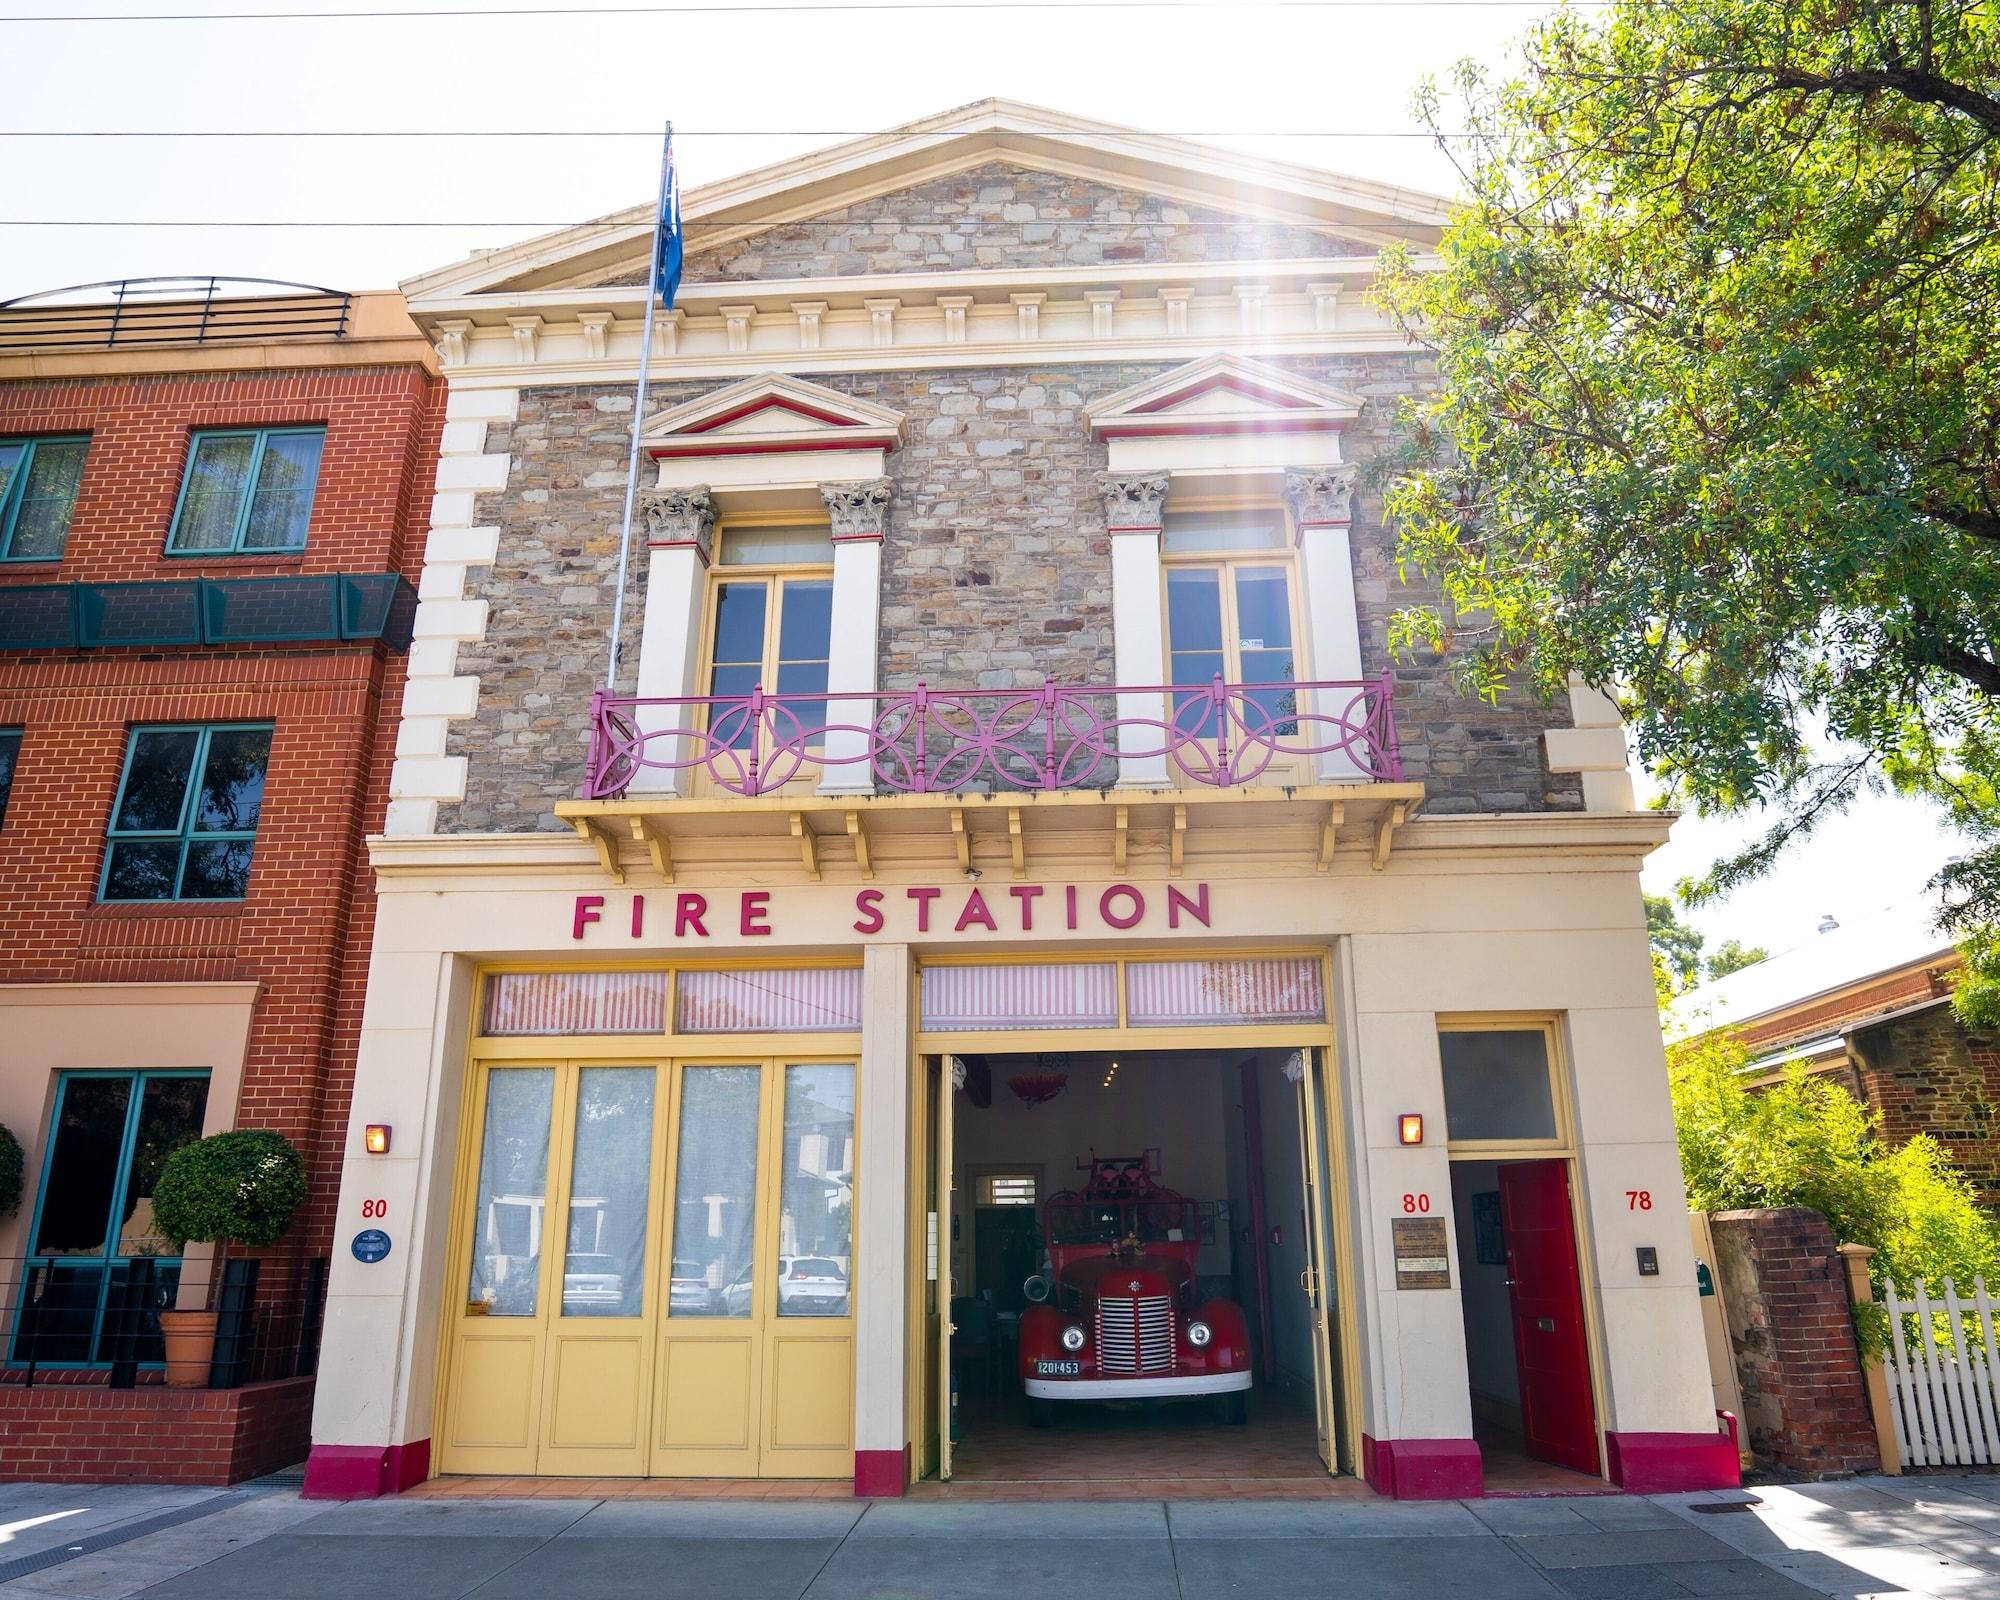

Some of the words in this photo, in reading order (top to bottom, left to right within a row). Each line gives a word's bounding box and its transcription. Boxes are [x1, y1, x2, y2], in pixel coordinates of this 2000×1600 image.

[573, 891, 772, 939] FIRE
[853, 883, 1211, 934] STATION
[362, 1199, 387, 1218] 80
[1403, 1193, 1430, 1213] 80
[1625, 1190, 1652, 1210] 78
